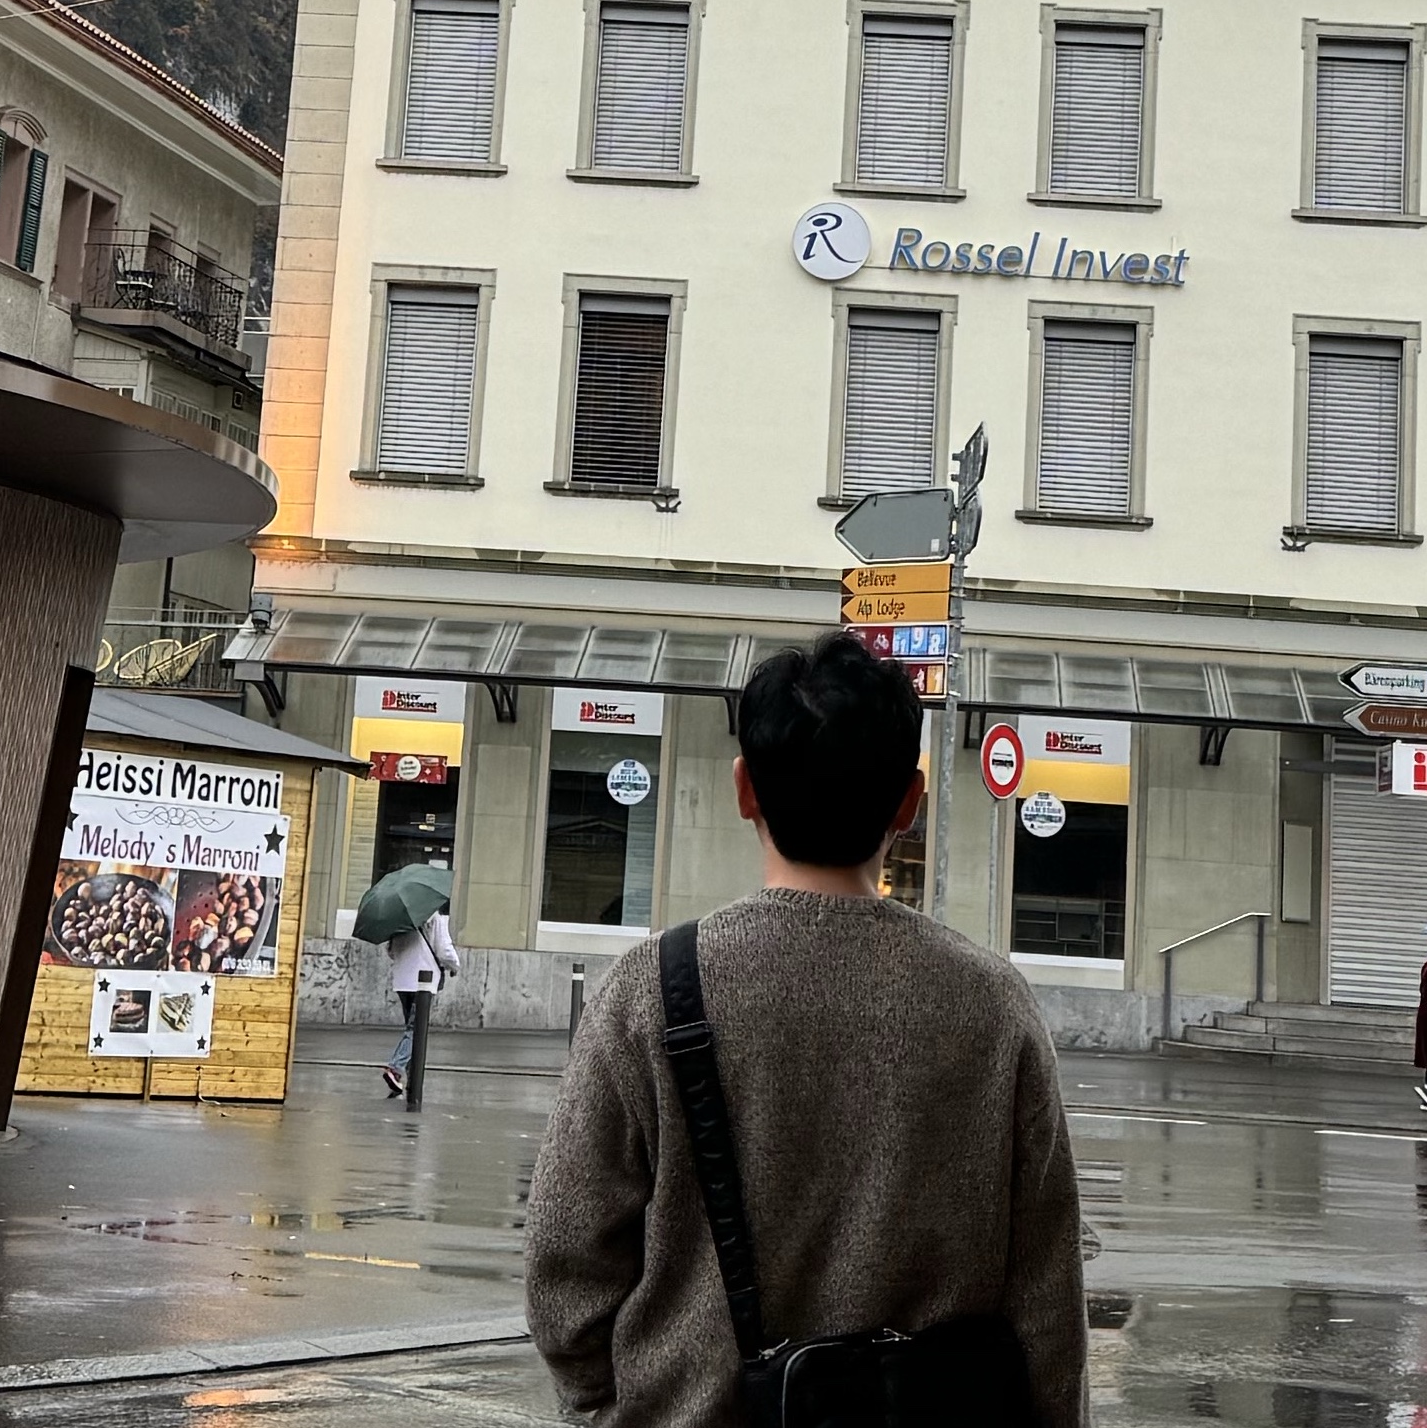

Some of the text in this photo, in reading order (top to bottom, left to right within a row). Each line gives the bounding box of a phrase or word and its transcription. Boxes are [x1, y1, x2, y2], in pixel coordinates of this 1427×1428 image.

[889, 227, 1190, 286] Rossel Invest
[856, 598, 906, 621] Alp Lodge
[397, 691, 421, 700] Inter
[397, 699, 437, 710] Discount
[595, 702, 619, 712] Inter
[1370, 711, 1408, 726] Casino
[1061, 732, 1085, 742] Inter
[79, 751, 281, 809] Heissi Marroni
[182, 834, 261, 872] Marroni
